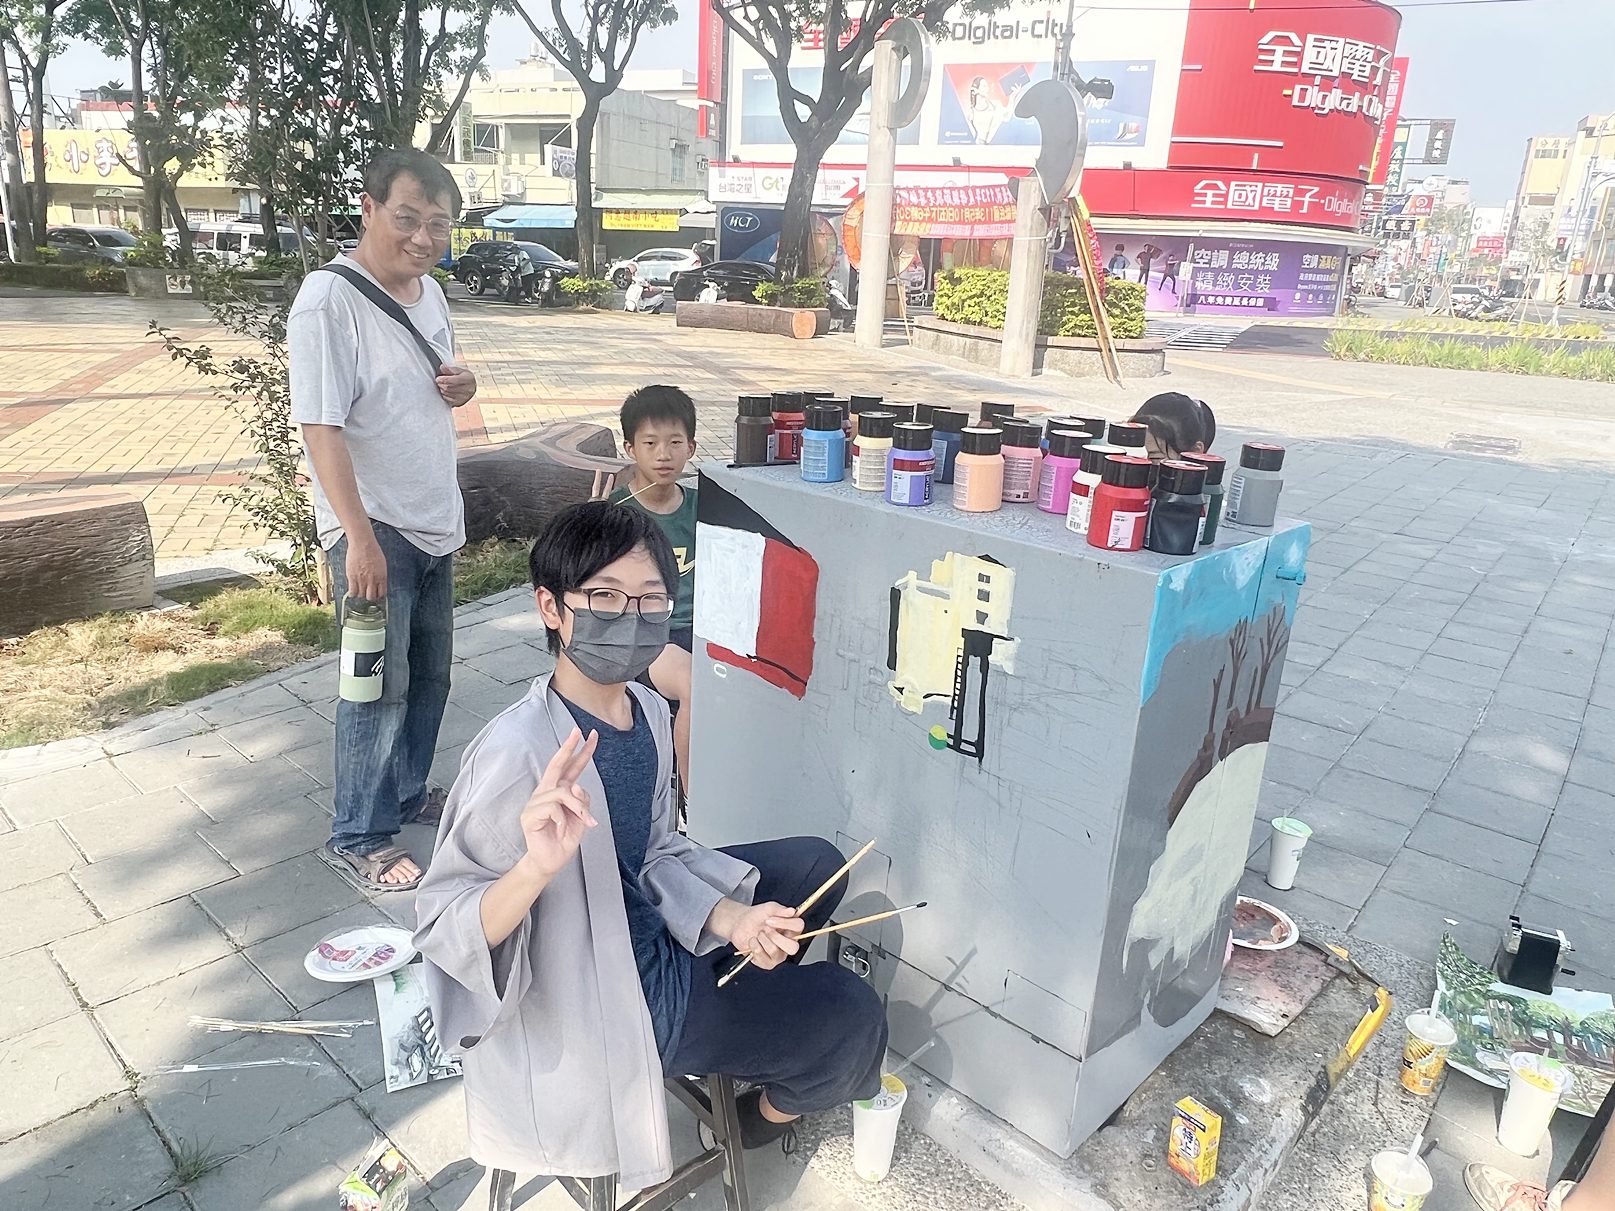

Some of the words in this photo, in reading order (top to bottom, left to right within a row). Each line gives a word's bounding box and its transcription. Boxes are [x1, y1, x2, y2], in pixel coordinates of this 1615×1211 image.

[1253, 31, 1392, 86] 全國電子
[1191, 180, 1320, 214] 全國電子
[1193, 249, 1229, 269] 空調
[1232, 250, 1280, 271] 總統級
[1195, 271, 1272, 293] 精緻安裝
